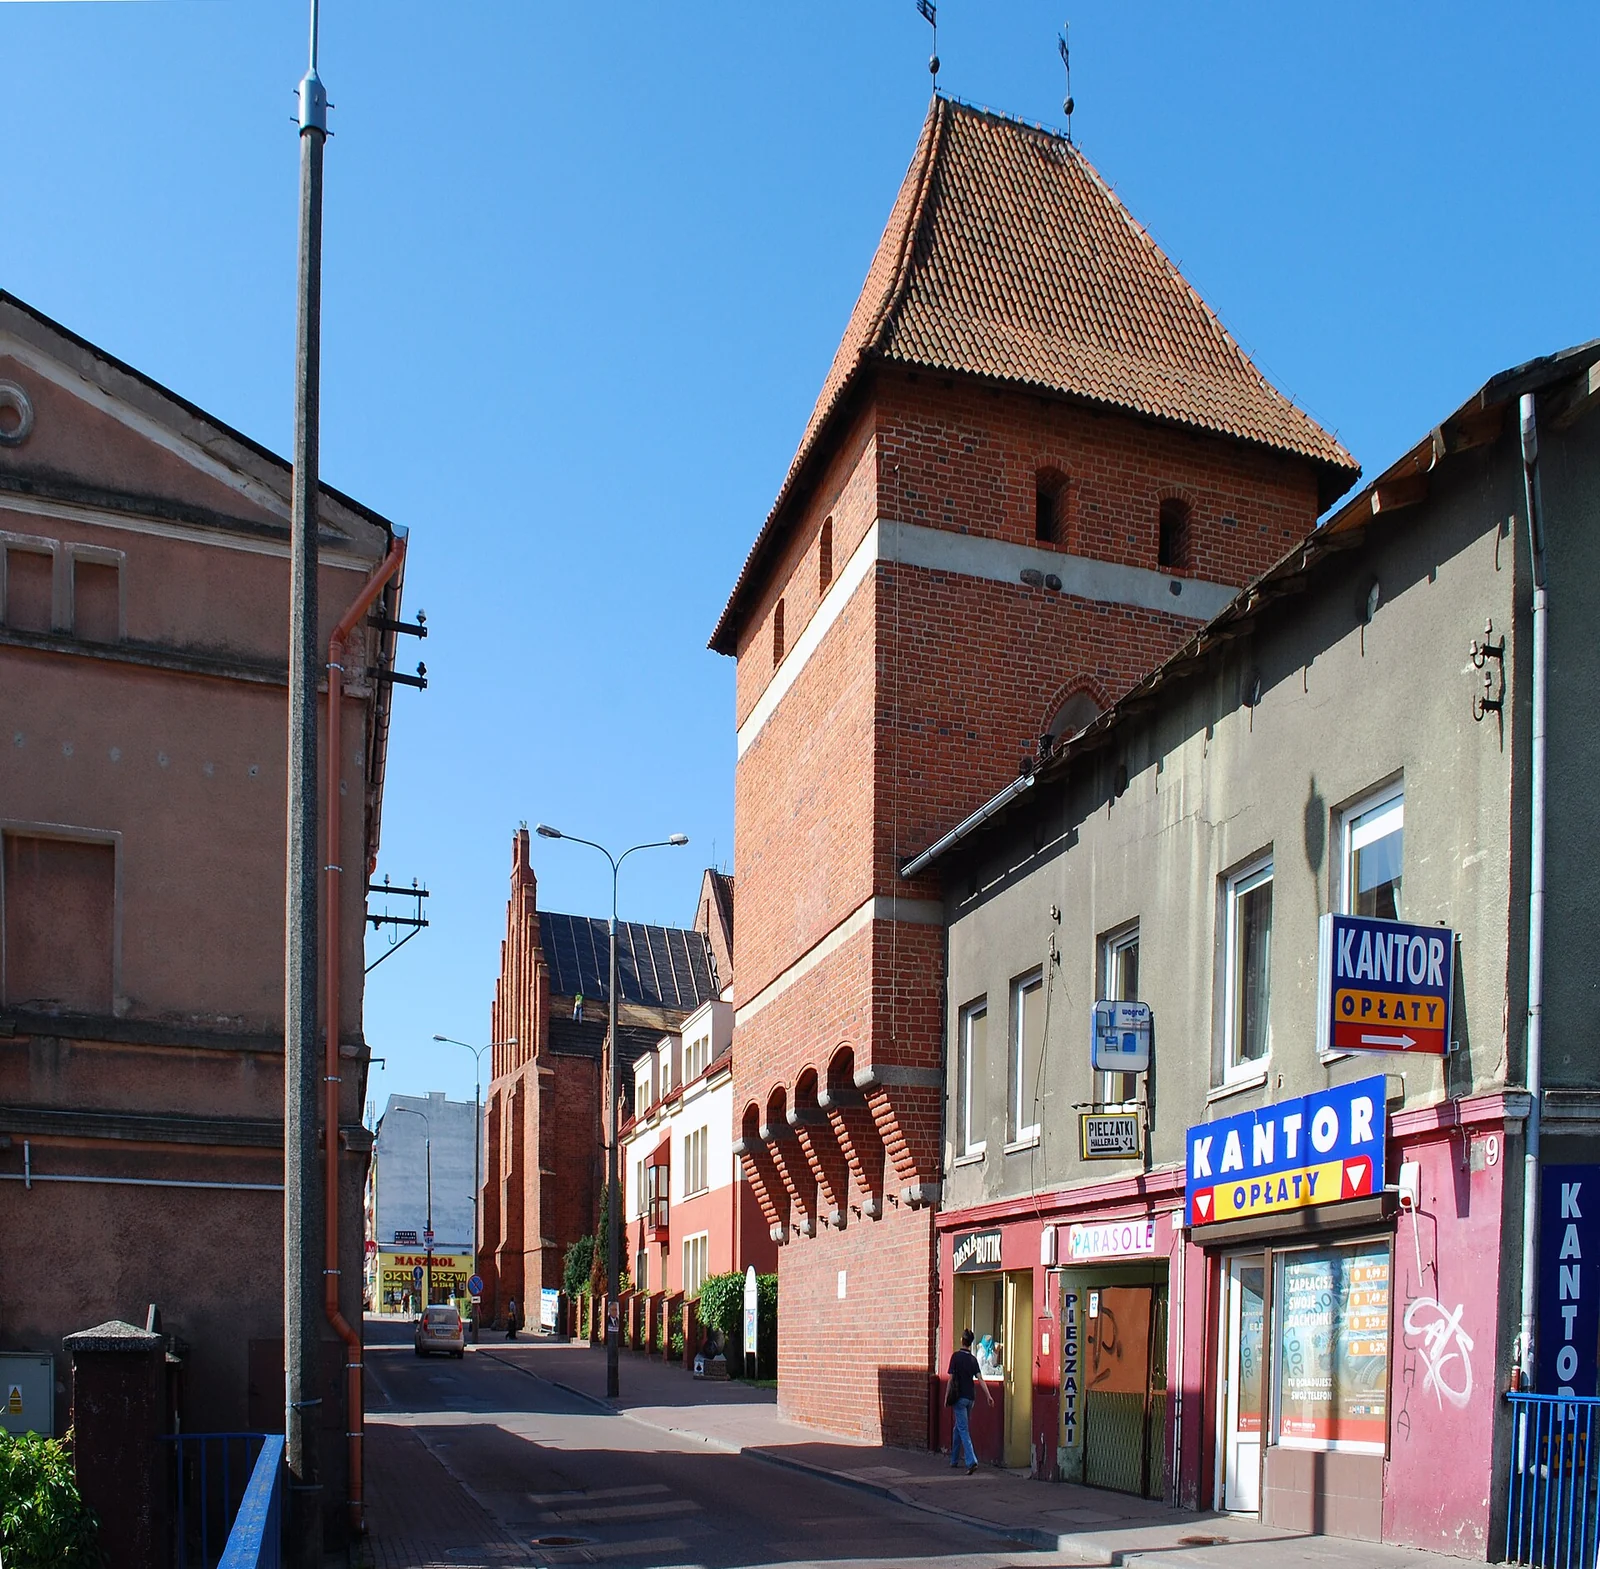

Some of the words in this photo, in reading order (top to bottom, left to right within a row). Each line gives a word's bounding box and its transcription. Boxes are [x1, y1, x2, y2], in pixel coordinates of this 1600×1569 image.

[1337, 927, 1445, 987] KANTOR
[1341, 995, 1438, 1022] OPŁATY
[1193, 1096, 1374, 1179] KANTOR
[1486, 1135, 1499, 1166] 9
[1233, 1171, 1320, 1209] OPŁATY
[976, 1234, 1002, 1264] BUTIK
[1074, 1225, 1153, 1254] PARASOLE
[384, 1271, 415, 1281] OKN
[1288, 1294, 1317, 1311] SWOJE
[1556, 1182, 1582, 1422] KANTOR
[1064, 1294, 1078, 1442] PIECZĄTKI
